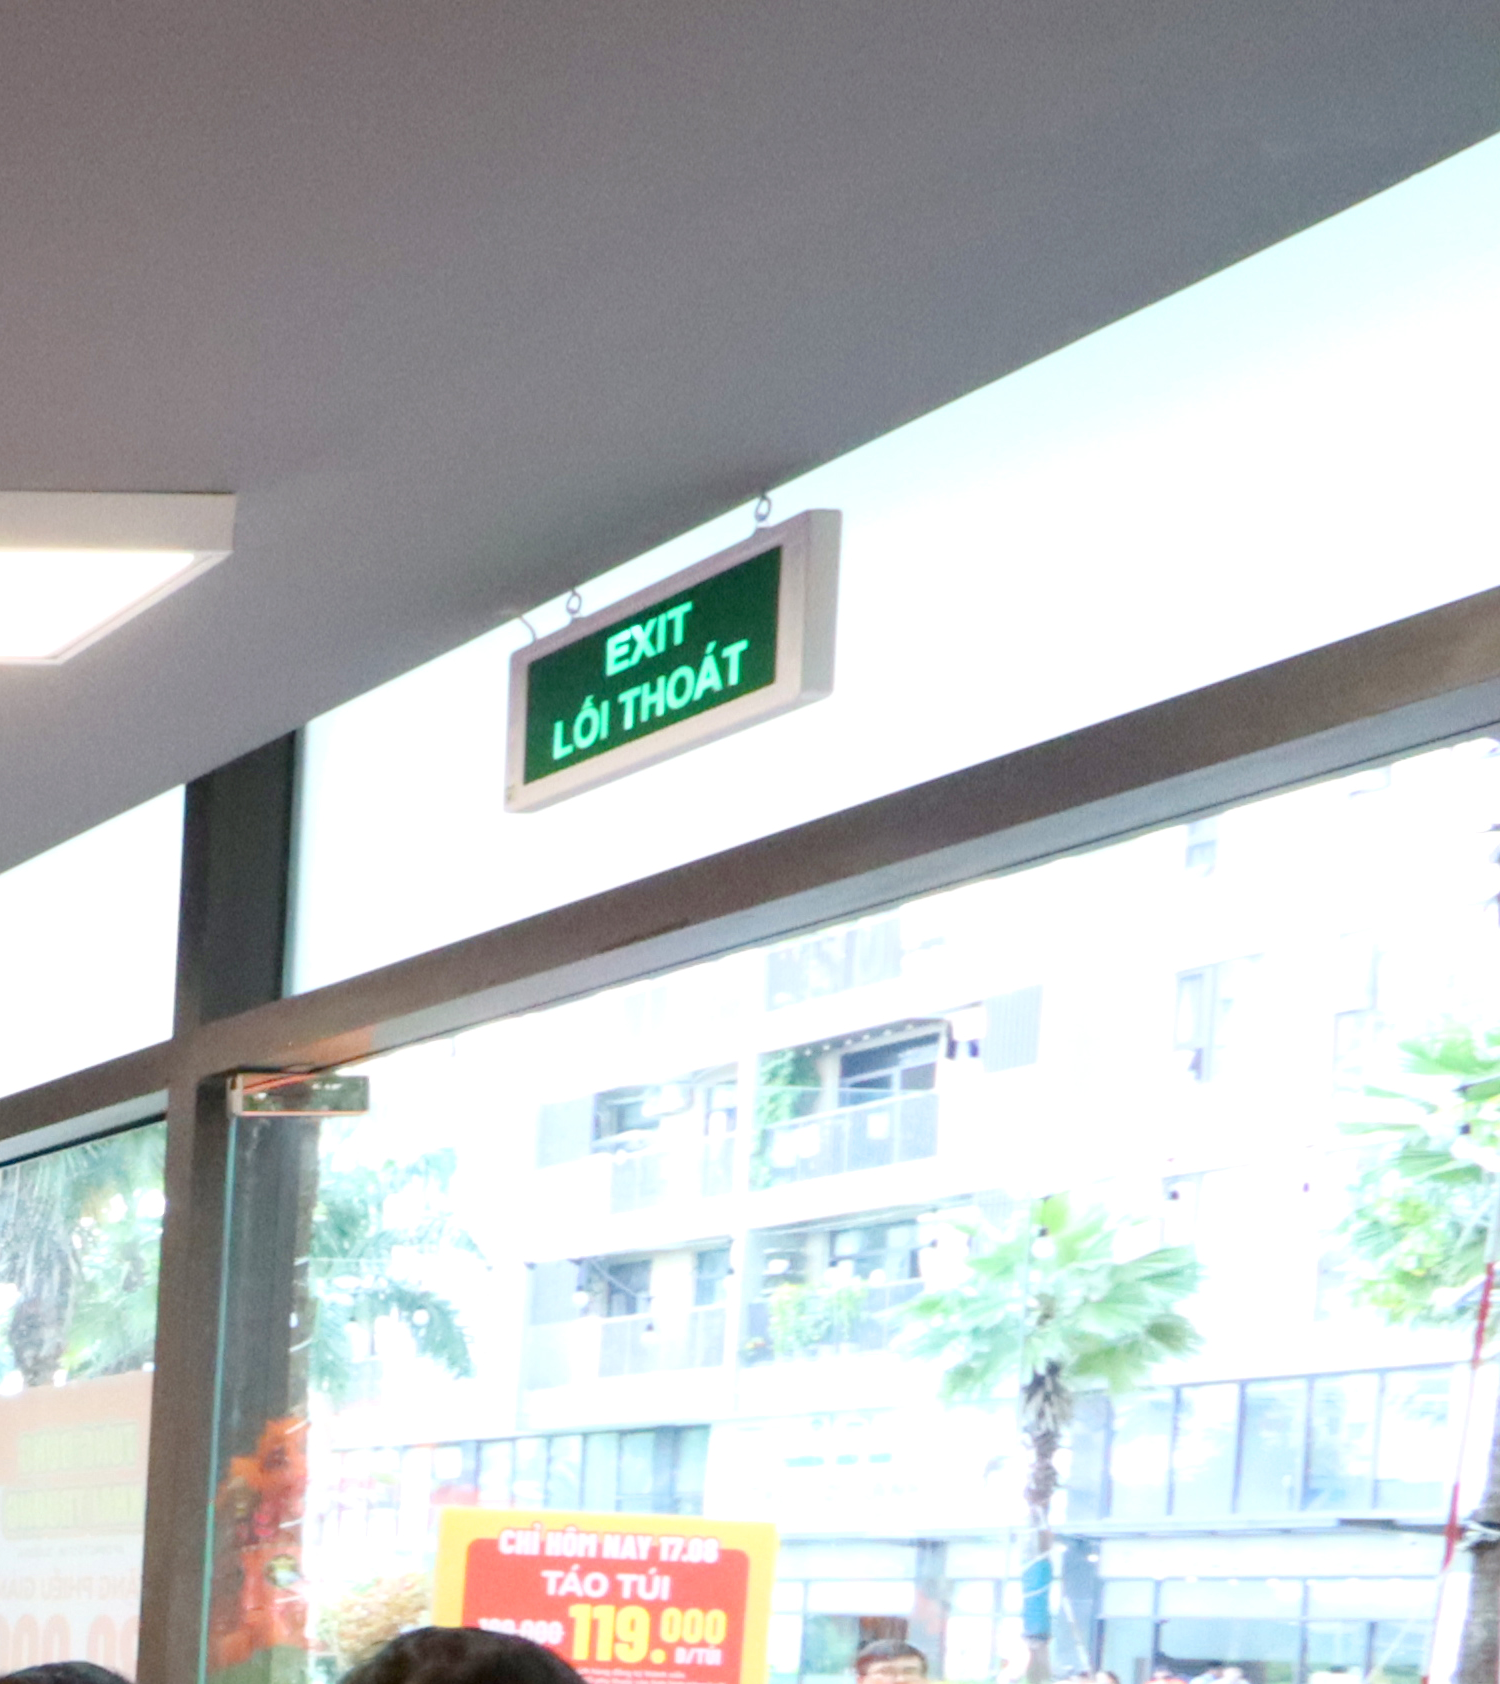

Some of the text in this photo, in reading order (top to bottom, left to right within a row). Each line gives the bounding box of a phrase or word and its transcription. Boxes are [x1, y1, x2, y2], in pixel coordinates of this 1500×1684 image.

[605, 602, 693, 677] EXIT
[552, 641, 748, 761] LỐI THOÁT
[545, 1527, 599, 1559] HÔM
[602, 1532, 653, 1562] NAY
[540, 1566, 671, 1600] TÁO TÚI
